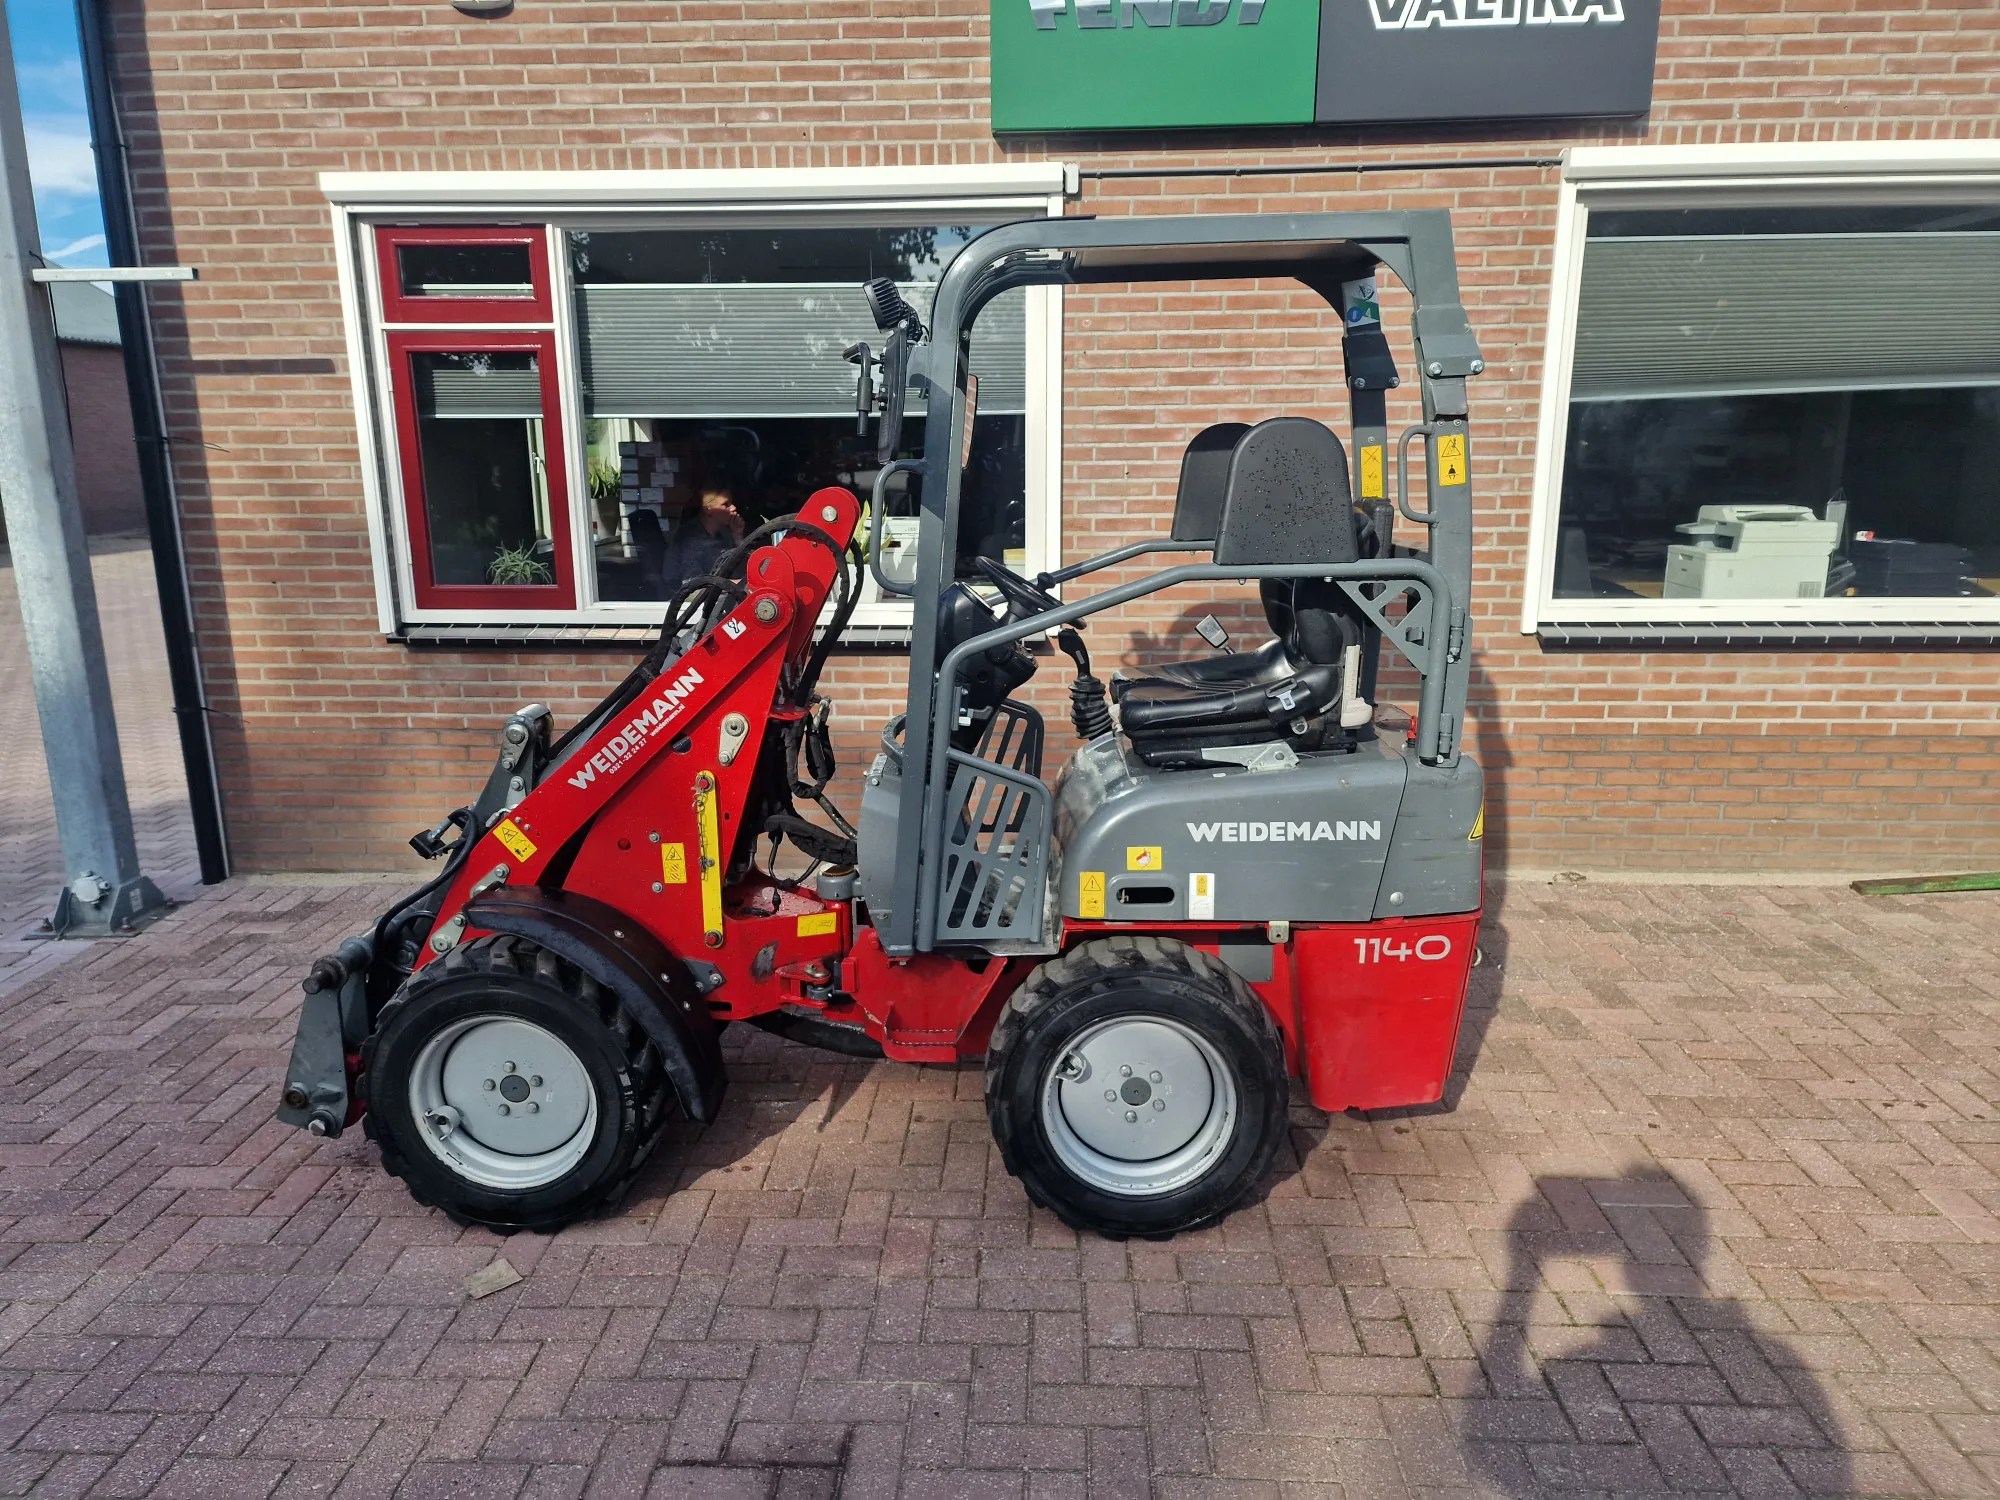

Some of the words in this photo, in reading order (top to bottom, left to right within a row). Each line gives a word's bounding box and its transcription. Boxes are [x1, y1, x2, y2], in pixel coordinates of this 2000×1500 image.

[567, 667, 704, 789] WEIDEMANN
[650, 704, 685, 737] weidemann.nl
[1187, 821, 1381, 842] WEIDEMANN
[1354, 935, 1451, 964] 1140
